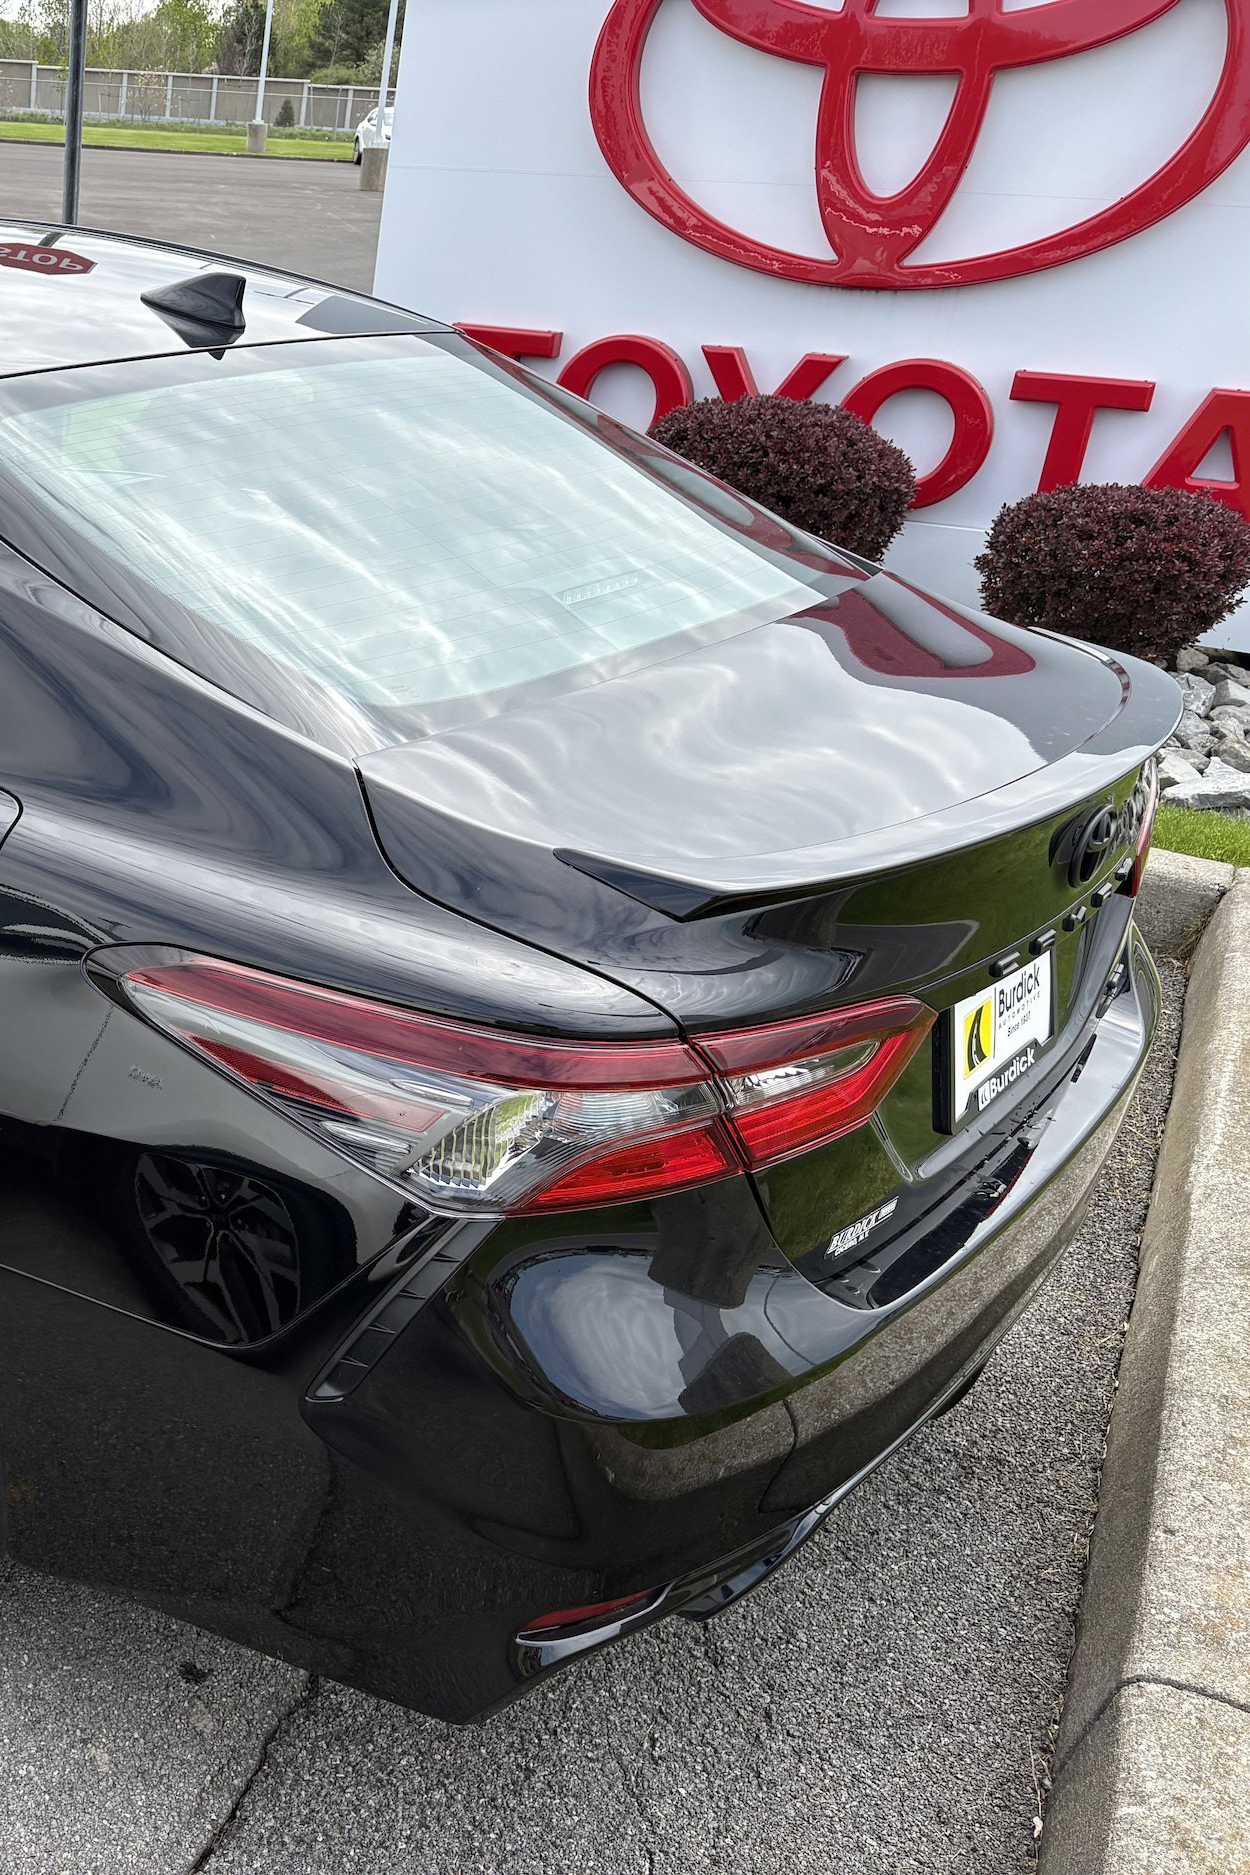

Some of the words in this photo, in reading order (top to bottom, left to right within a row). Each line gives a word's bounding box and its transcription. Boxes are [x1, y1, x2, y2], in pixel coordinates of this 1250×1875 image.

[997, 990, 1041, 1030] AUTOMOTIVE
[998, 963, 1041, 1018] Burdick
[990, 1047, 1036, 1100] Burdick
[829, 1211, 879, 1252] BURDICK
